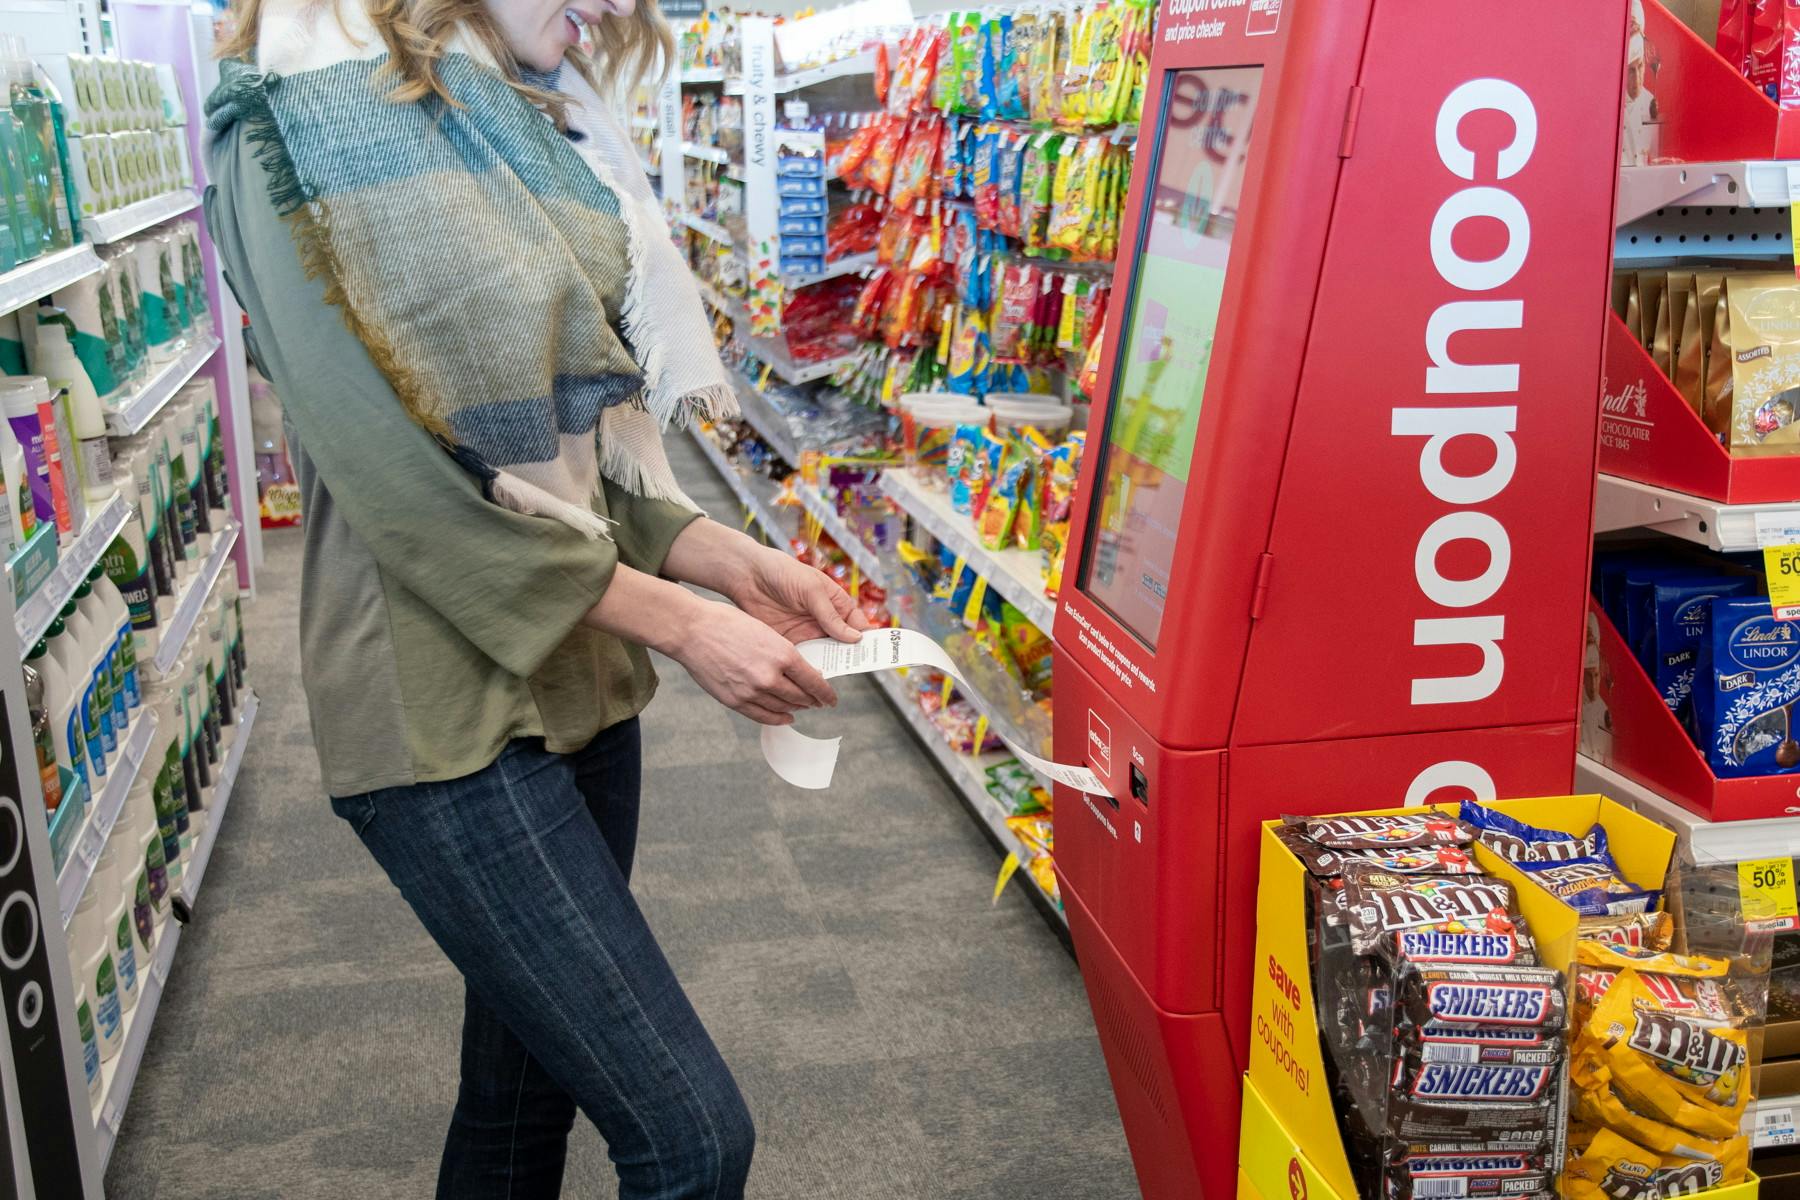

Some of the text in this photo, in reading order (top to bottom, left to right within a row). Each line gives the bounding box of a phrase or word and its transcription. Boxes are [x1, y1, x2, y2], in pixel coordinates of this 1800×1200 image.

[1165, 18, 1226, 45] and price checker
[752, 112, 766, 167] chewy
[1391, 77, 1538, 706] coupon
[1602, 420, 1651, 441] CHOCOLATIER
[1600, 433, 1631, 451] NCE 1845
[1686, 627, 1704, 637] LIN
[1741, 625, 1779, 642] Lindt
[1114, 649, 1131, 670] coupons
[1130, 663, 1140, 677] and
[1668, 651, 1691, 666] DARK
[1743, 647, 1789, 659] LINDOR
[1725, 674, 1748, 690] DARK
[1131, 745, 1145, 767] Scan
[1369, 874, 1394, 883] MILK
[1403, 933, 1509, 957] SNICKERS
[1268, 954, 1301, 1012] save
[1505, 974, 1520, 982] MILK
[1521, 974, 1554, 983] CHOCOLATE
[1431, 985, 1544, 1020] SNICKERS
[1271, 998, 1295, 1045] with
[1256, 1013, 1310, 1097] coupons!
[1516, 1051, 1547, 1063] PACKED
[1417, 1064, 1543, 1097] SNICKERS
[1618, 1162, 1648, 1174] PEANUT
[1504, 1180, 1535, 1192] PACKED
